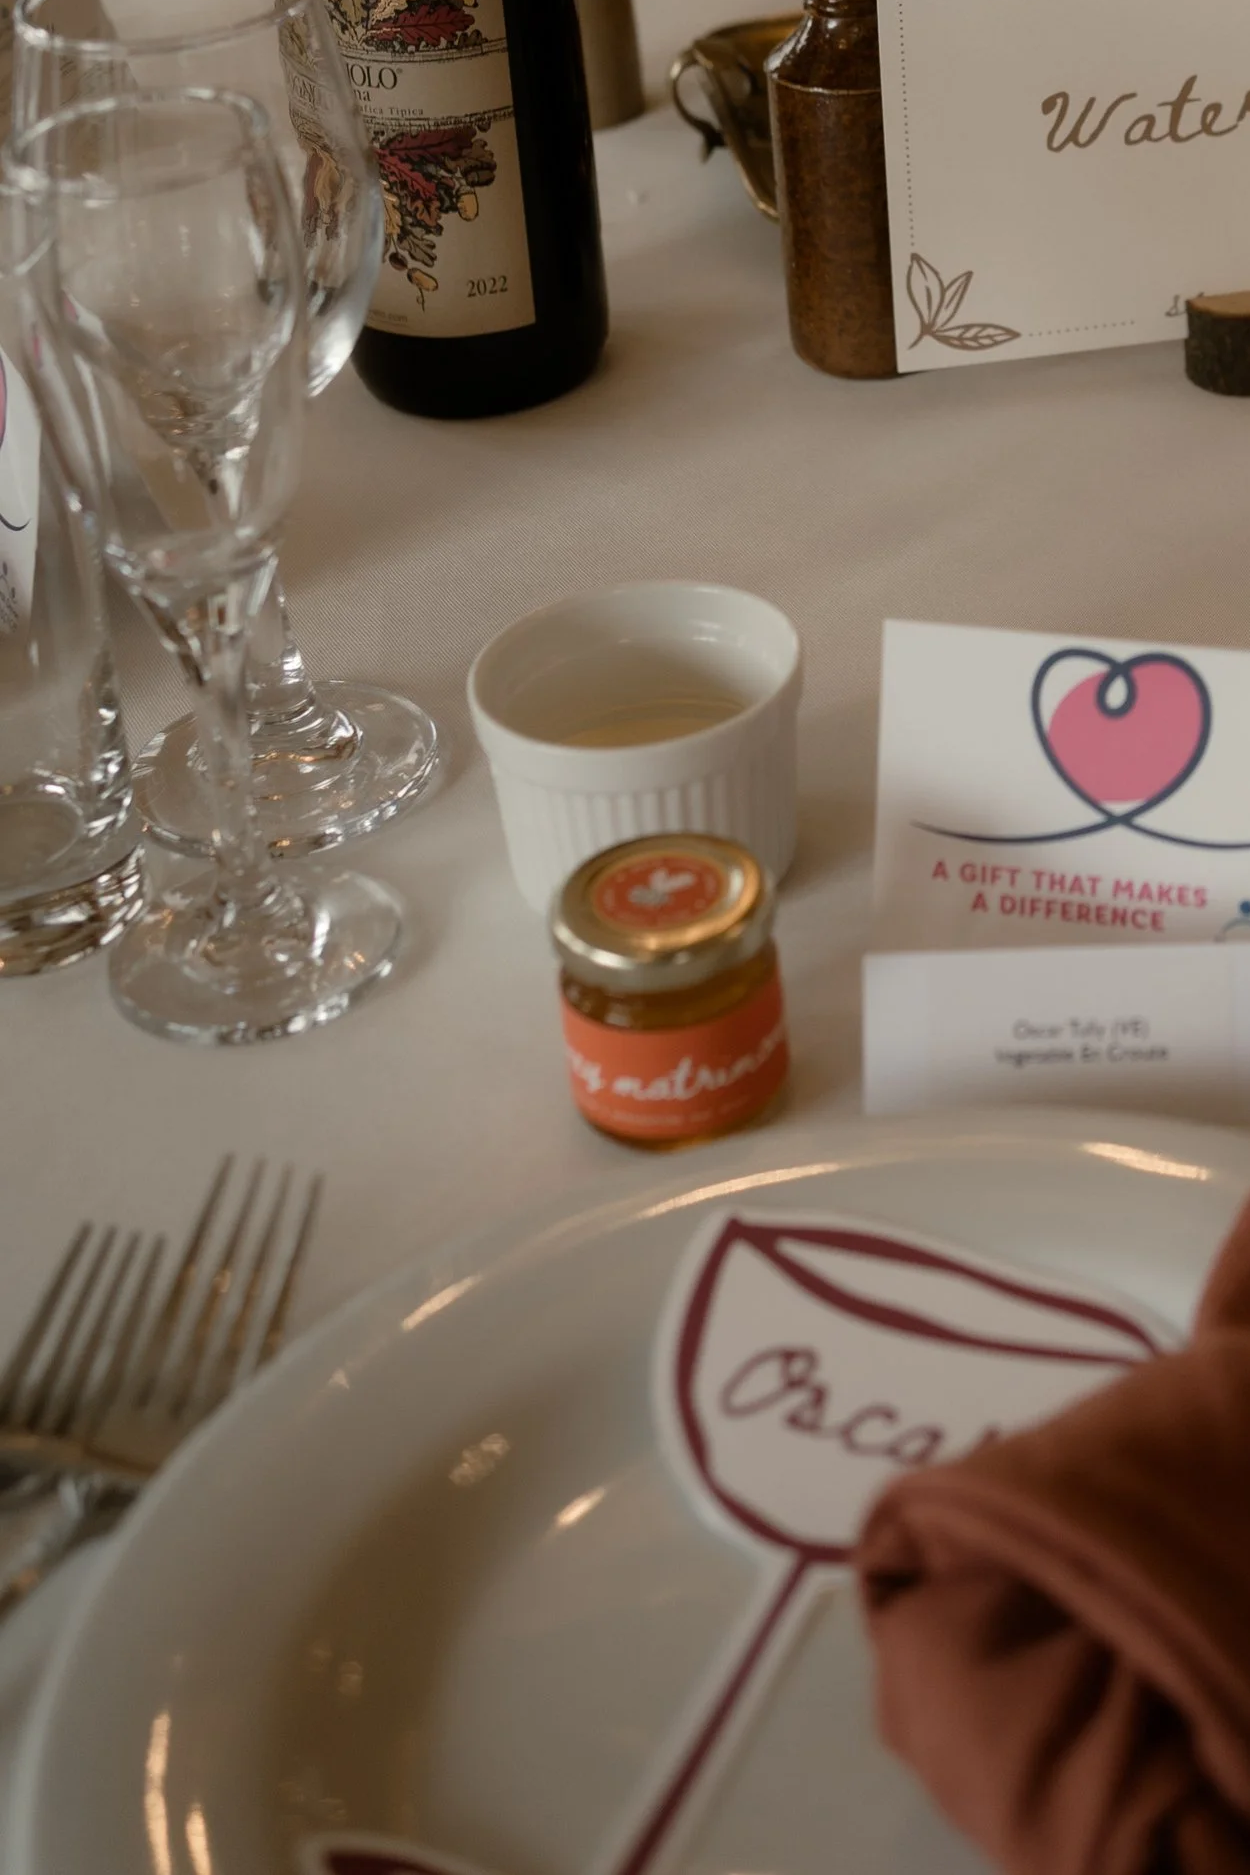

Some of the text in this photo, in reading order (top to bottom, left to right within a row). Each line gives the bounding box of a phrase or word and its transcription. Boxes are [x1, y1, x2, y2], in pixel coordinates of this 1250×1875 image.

[466, 275, 509, 298] 2022
[932, 860, 1210, 910] A GIFT THAT MAKES
[971, 891, 1167, 933] A DIFFERENCE
[718, 1344, 1000, 1467] Osca
